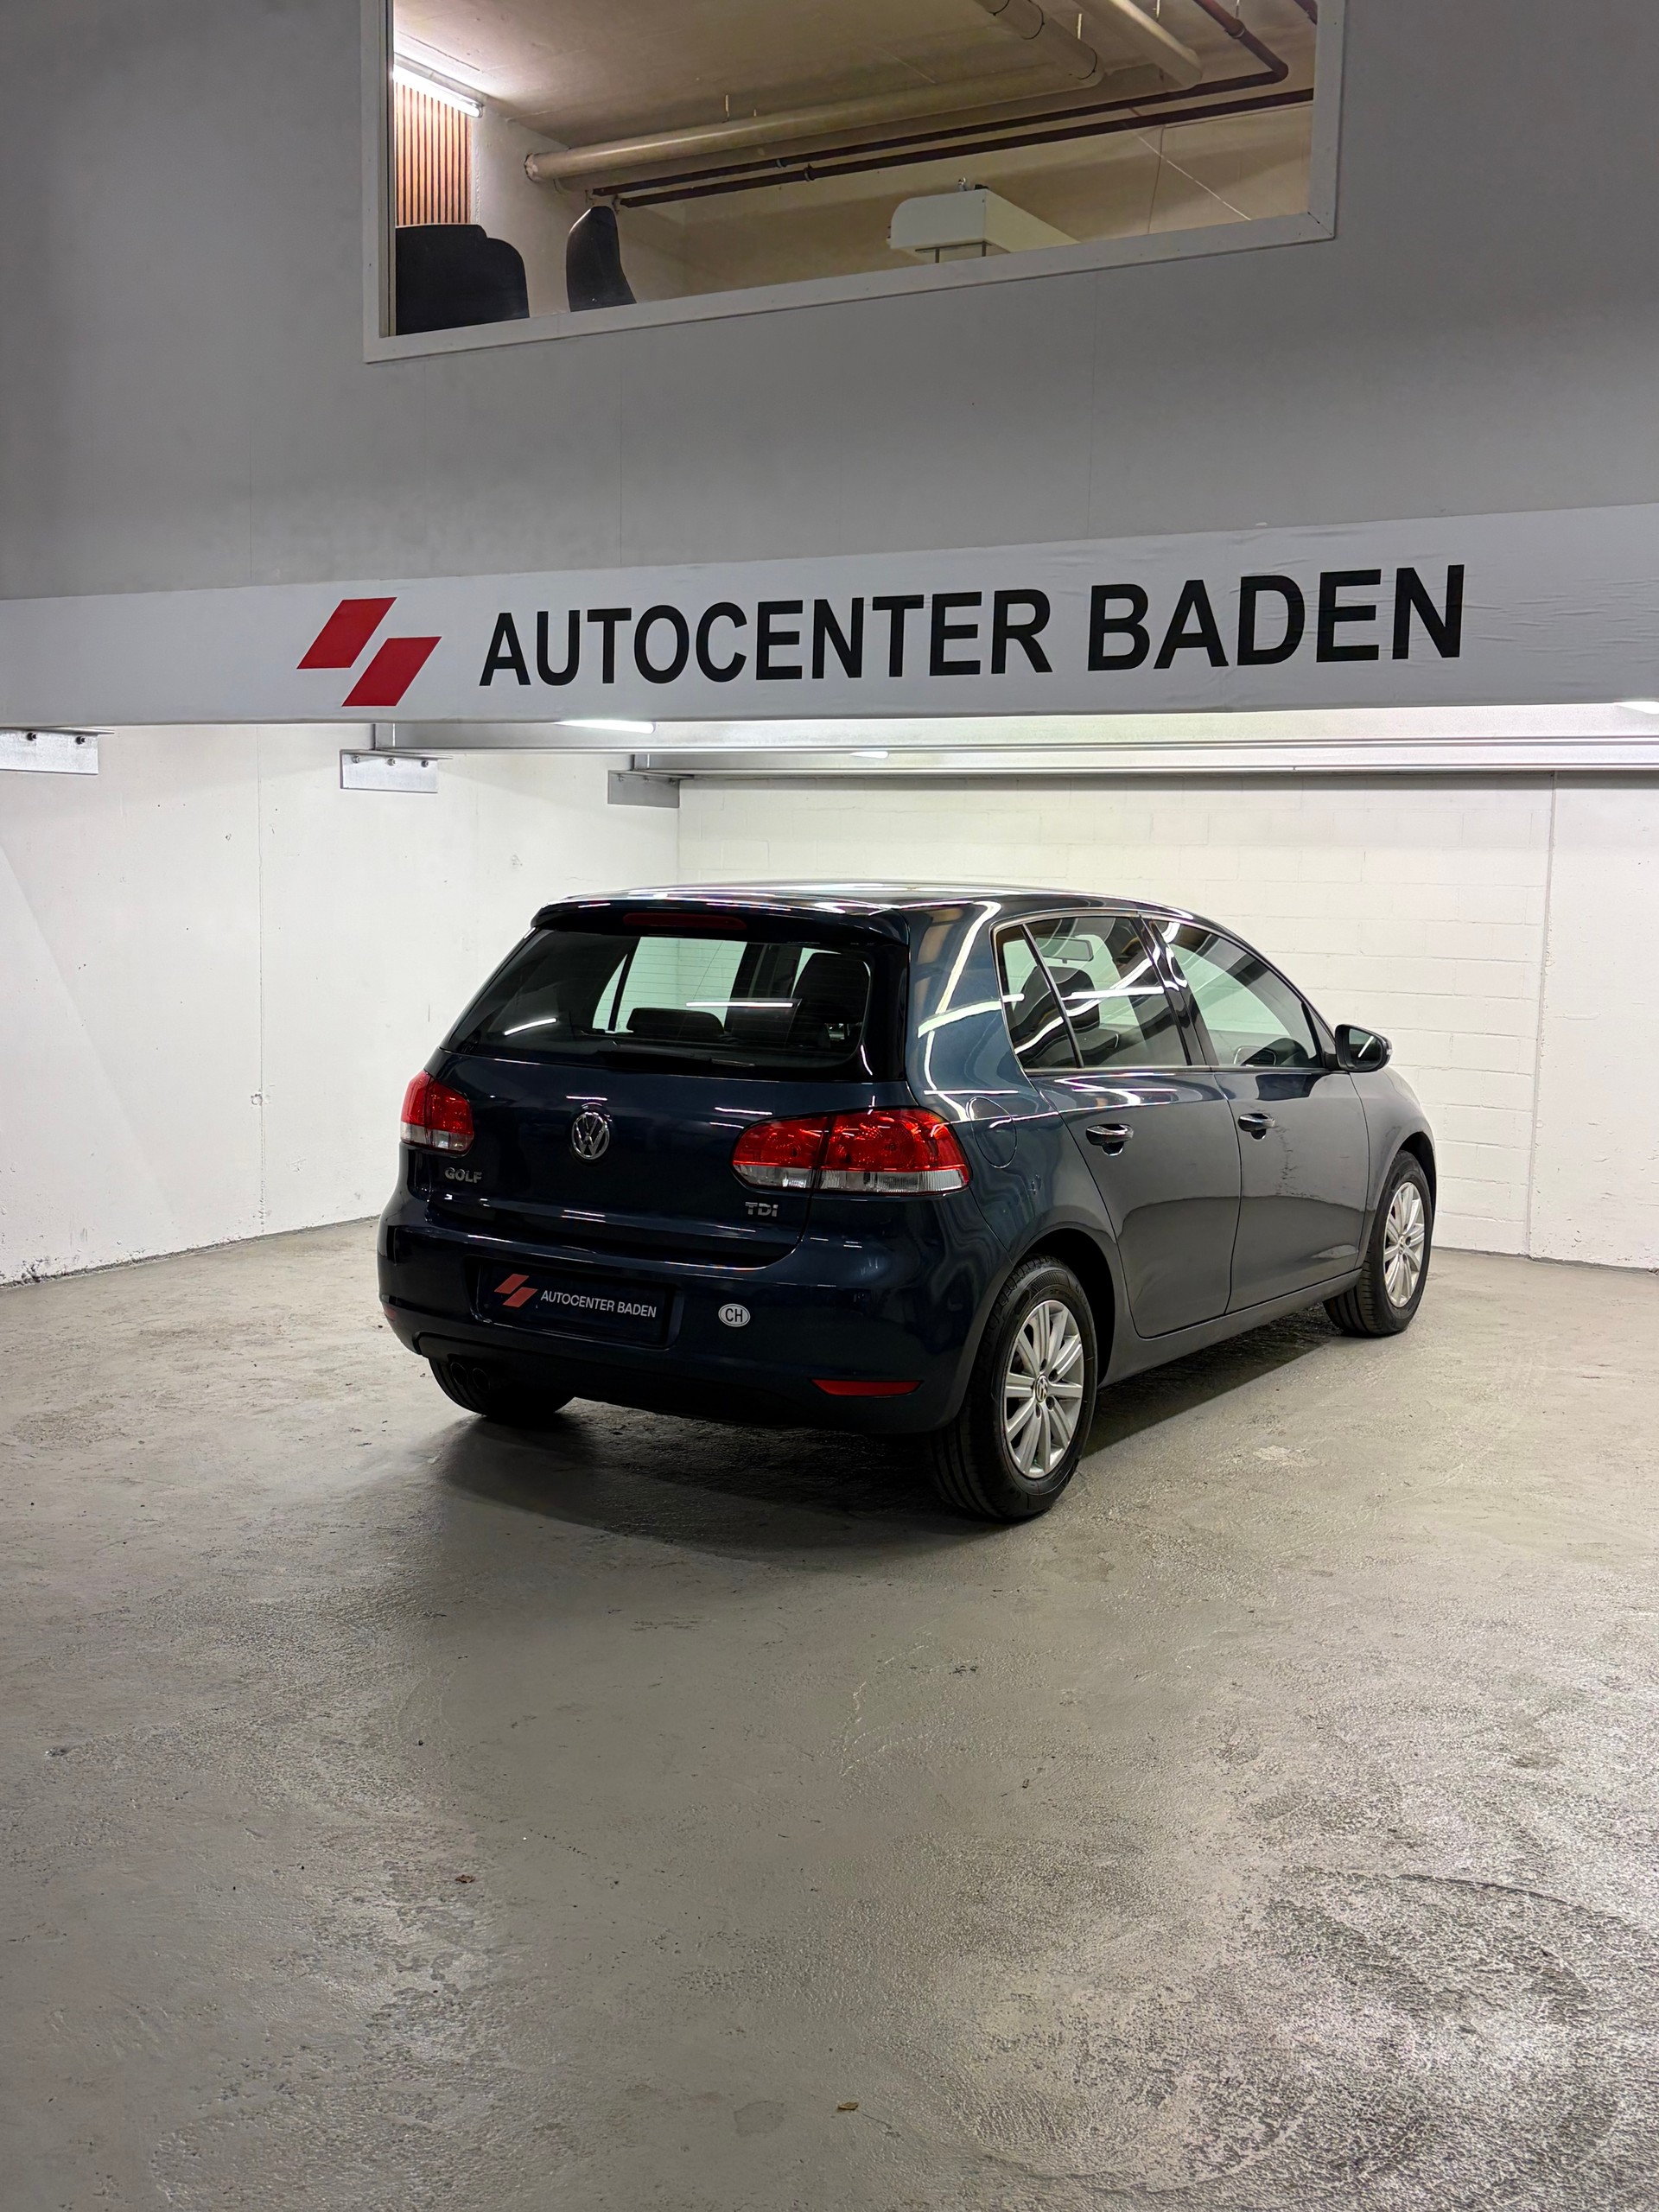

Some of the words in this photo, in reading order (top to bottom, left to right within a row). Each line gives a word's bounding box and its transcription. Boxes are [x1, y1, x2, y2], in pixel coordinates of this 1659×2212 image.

[480, 588, 1053, 686] AUTOCENTER
[1088, 564, 1465, 671] BADEN
[572, 1112, 610, 1160] VW
[445, 1166, 482, 1183] GOLF
[540, 1290, 615, 1313] AUTOCENTER
[617, 1301, 657, 1318] BADEN
[725, 1307, 743, 1322] CH
